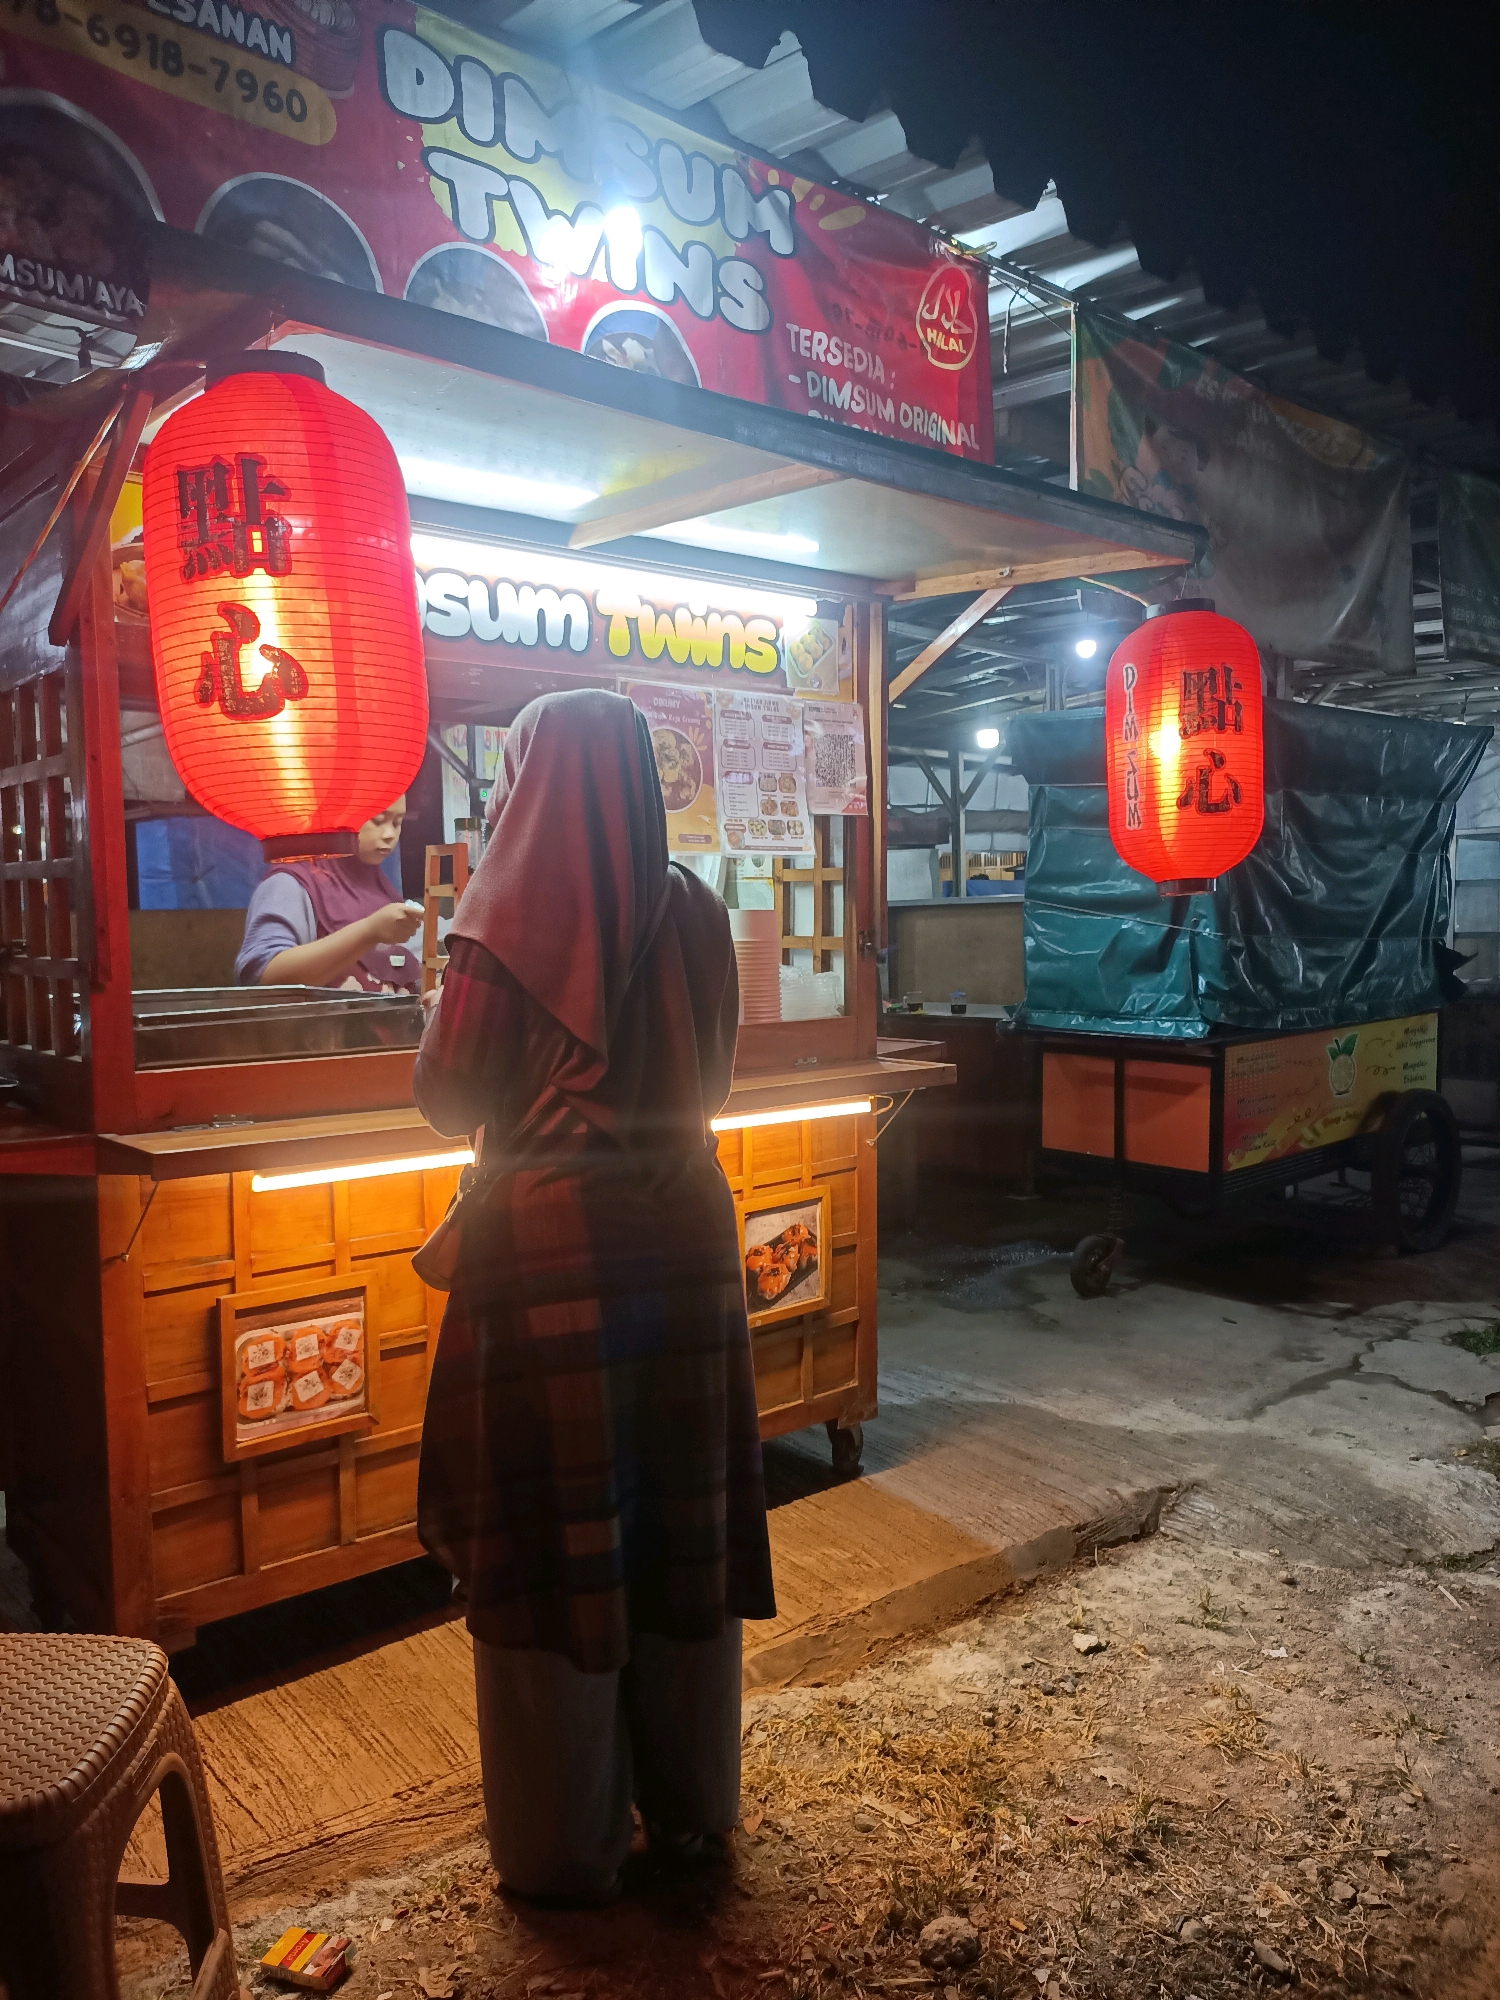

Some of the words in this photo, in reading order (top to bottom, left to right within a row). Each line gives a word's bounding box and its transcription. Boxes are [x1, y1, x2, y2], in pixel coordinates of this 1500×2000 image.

[382, 26, 797, 256] DIMSUM
[422, 146, 773, 334] TWINS
[785, 322, 886, 385] TERSEDIA
[806, 370, 896, 424] DIMSUM
[899, 401, 980, 451] ORIGINAL
[414, 568, 591, 655] sum
[595, 588, 782, 677] Twins
